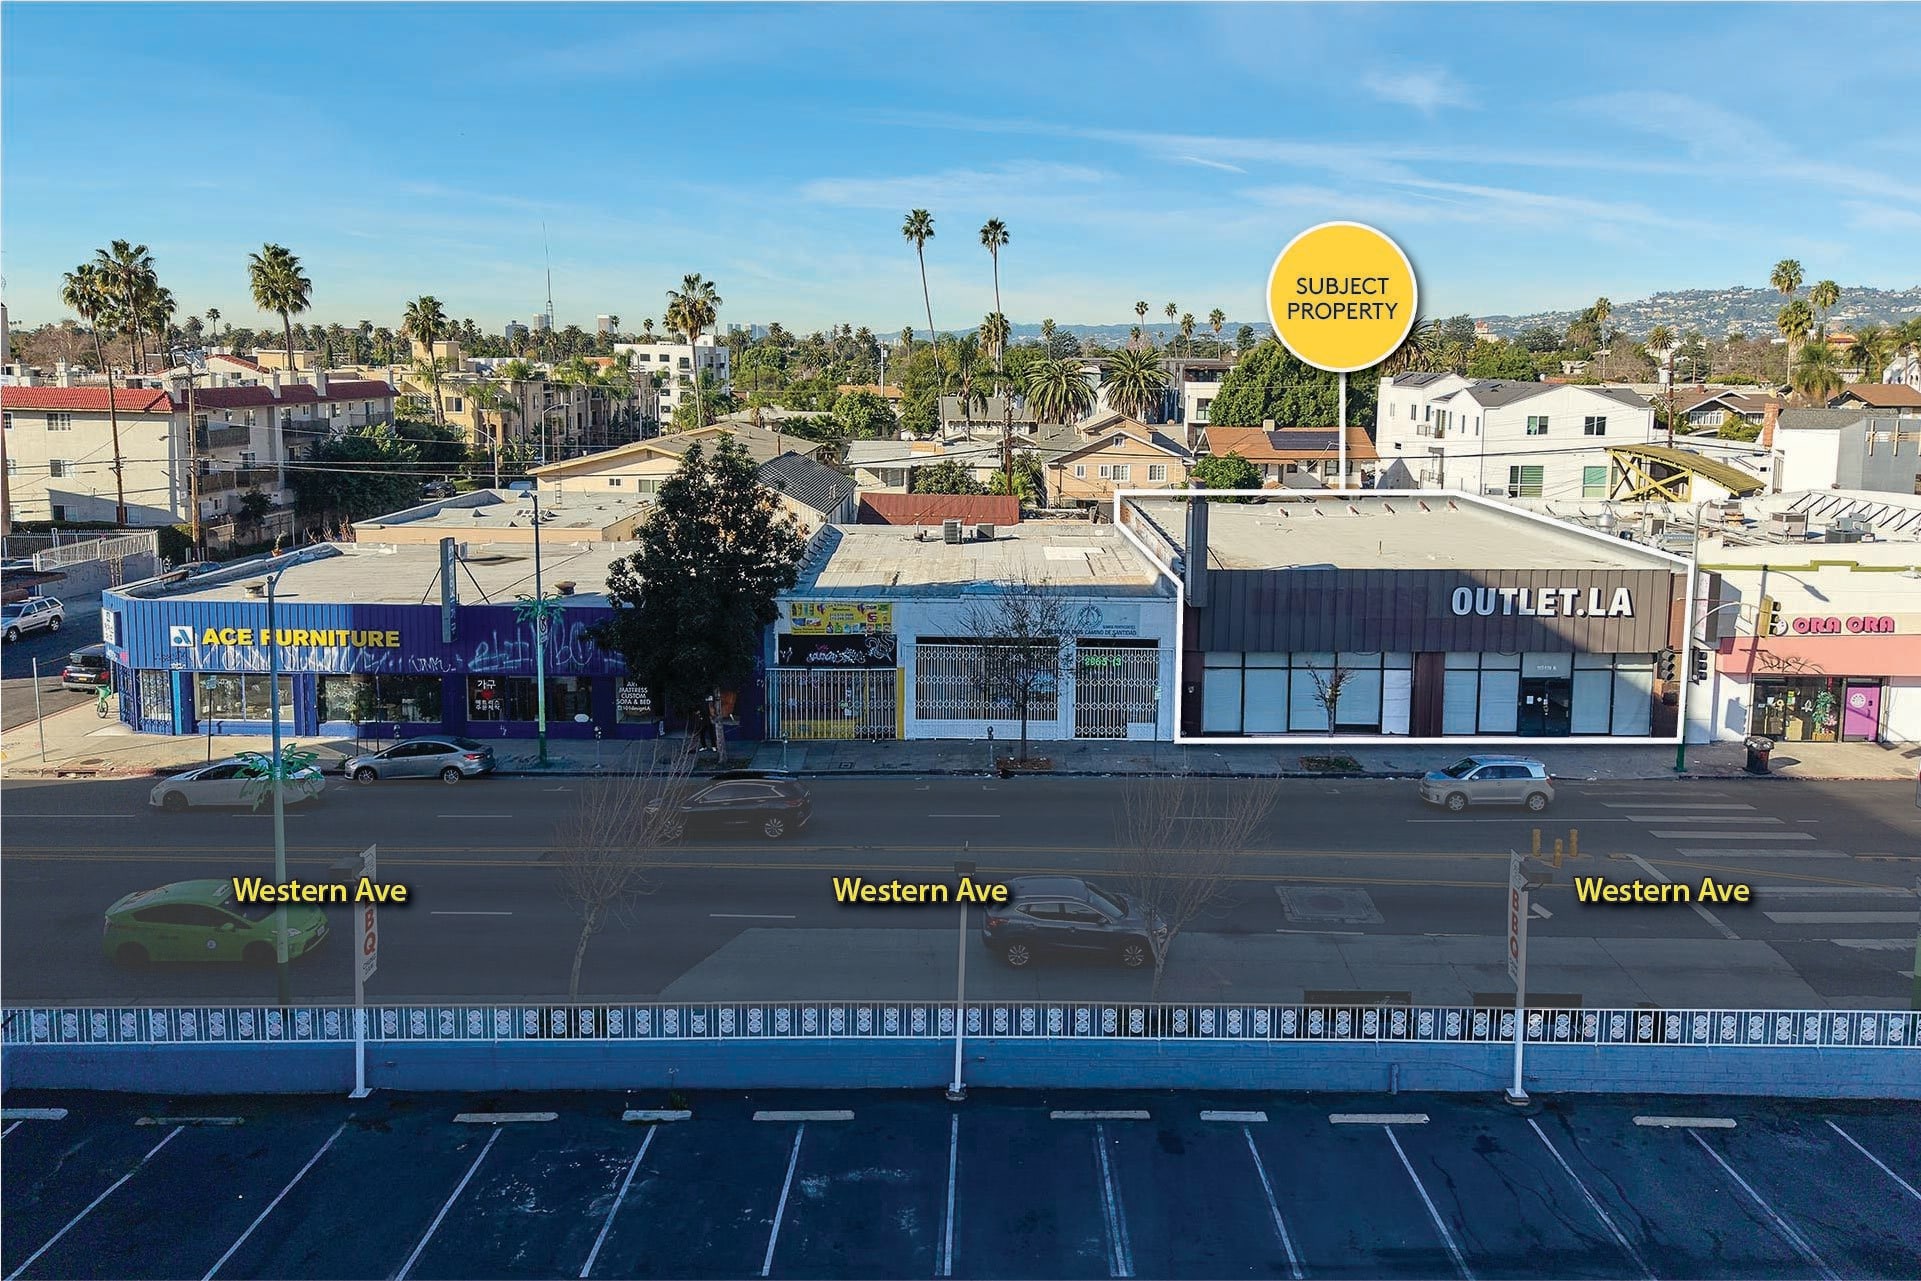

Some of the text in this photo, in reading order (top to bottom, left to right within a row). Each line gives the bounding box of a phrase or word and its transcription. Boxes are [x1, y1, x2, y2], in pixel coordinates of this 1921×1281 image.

[1451, 586, 1635, 618] OUTLET.LA
[1792, 616, 1896, 634] ORA ORA
[201, 628, 401, 647] ACE FURNITURE
